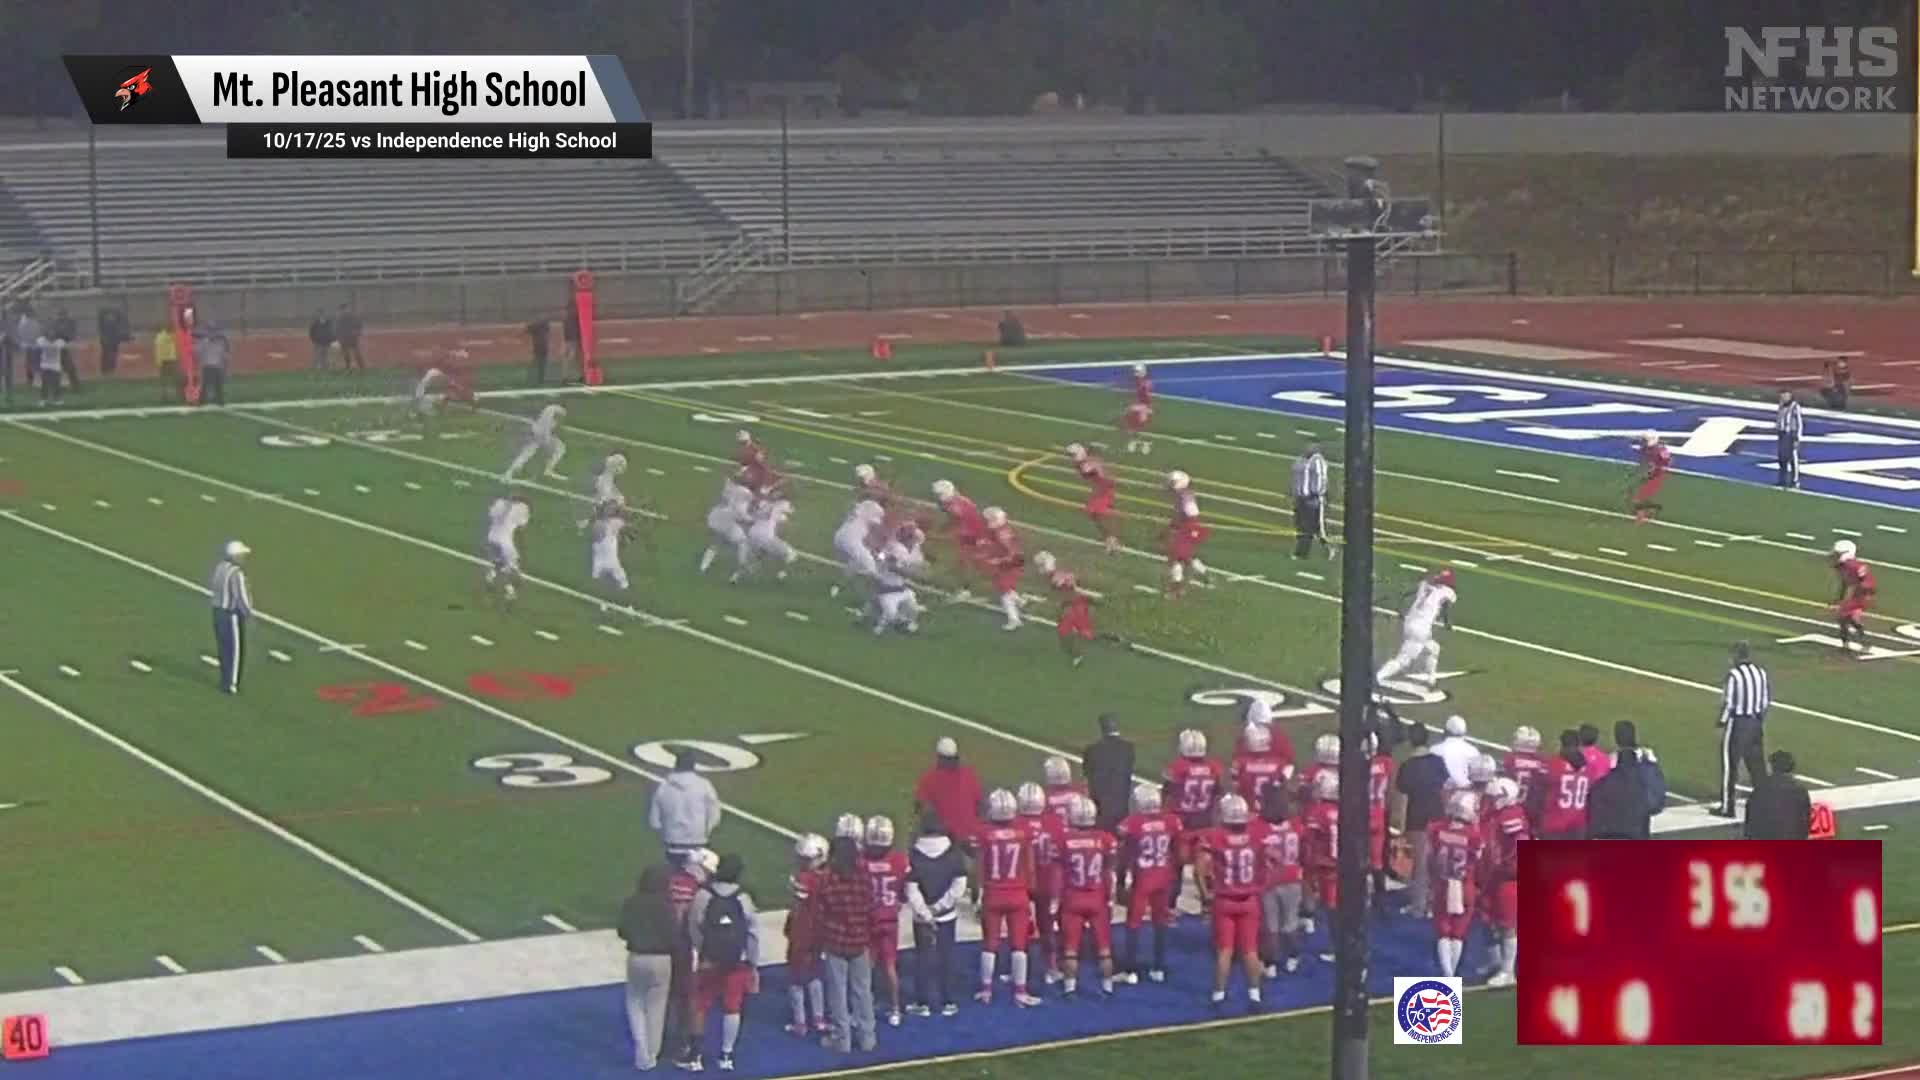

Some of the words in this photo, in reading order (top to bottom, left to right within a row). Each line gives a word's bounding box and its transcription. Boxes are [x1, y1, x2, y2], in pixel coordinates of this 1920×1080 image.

[1180, 779, 1216, 809] 55
[1558, 774, 1589, 810] 50
[1809, 806, 1831, 834] 20
[990, 843, 1021, 881] 17
[1070, 852, 1104, 888] 34
[9, 1017, 42, 1052] 40
